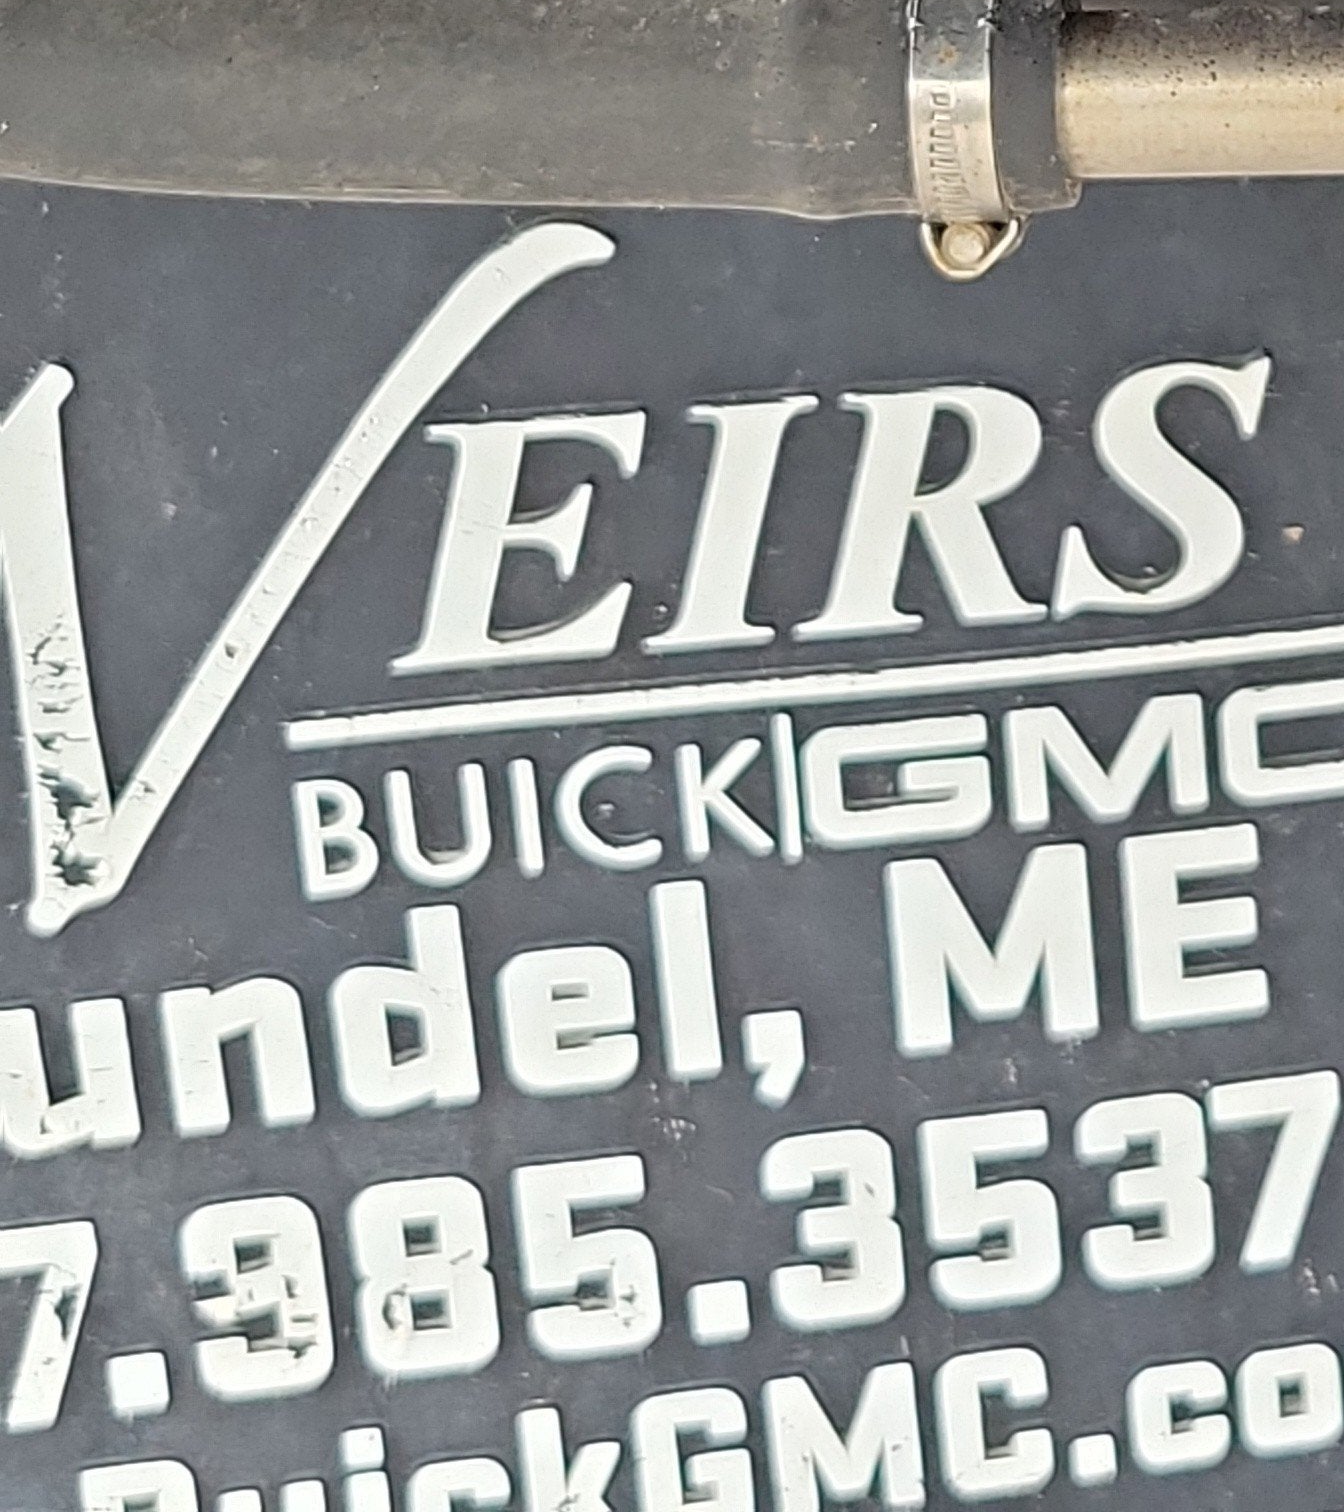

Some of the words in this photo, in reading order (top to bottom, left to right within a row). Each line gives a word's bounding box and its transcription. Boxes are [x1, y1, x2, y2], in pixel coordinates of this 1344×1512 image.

[0, 220, 1272, 938] VEIRS
[291, 738, 776, 902] BUICK
[884, 823, 1271, 1058] ME
